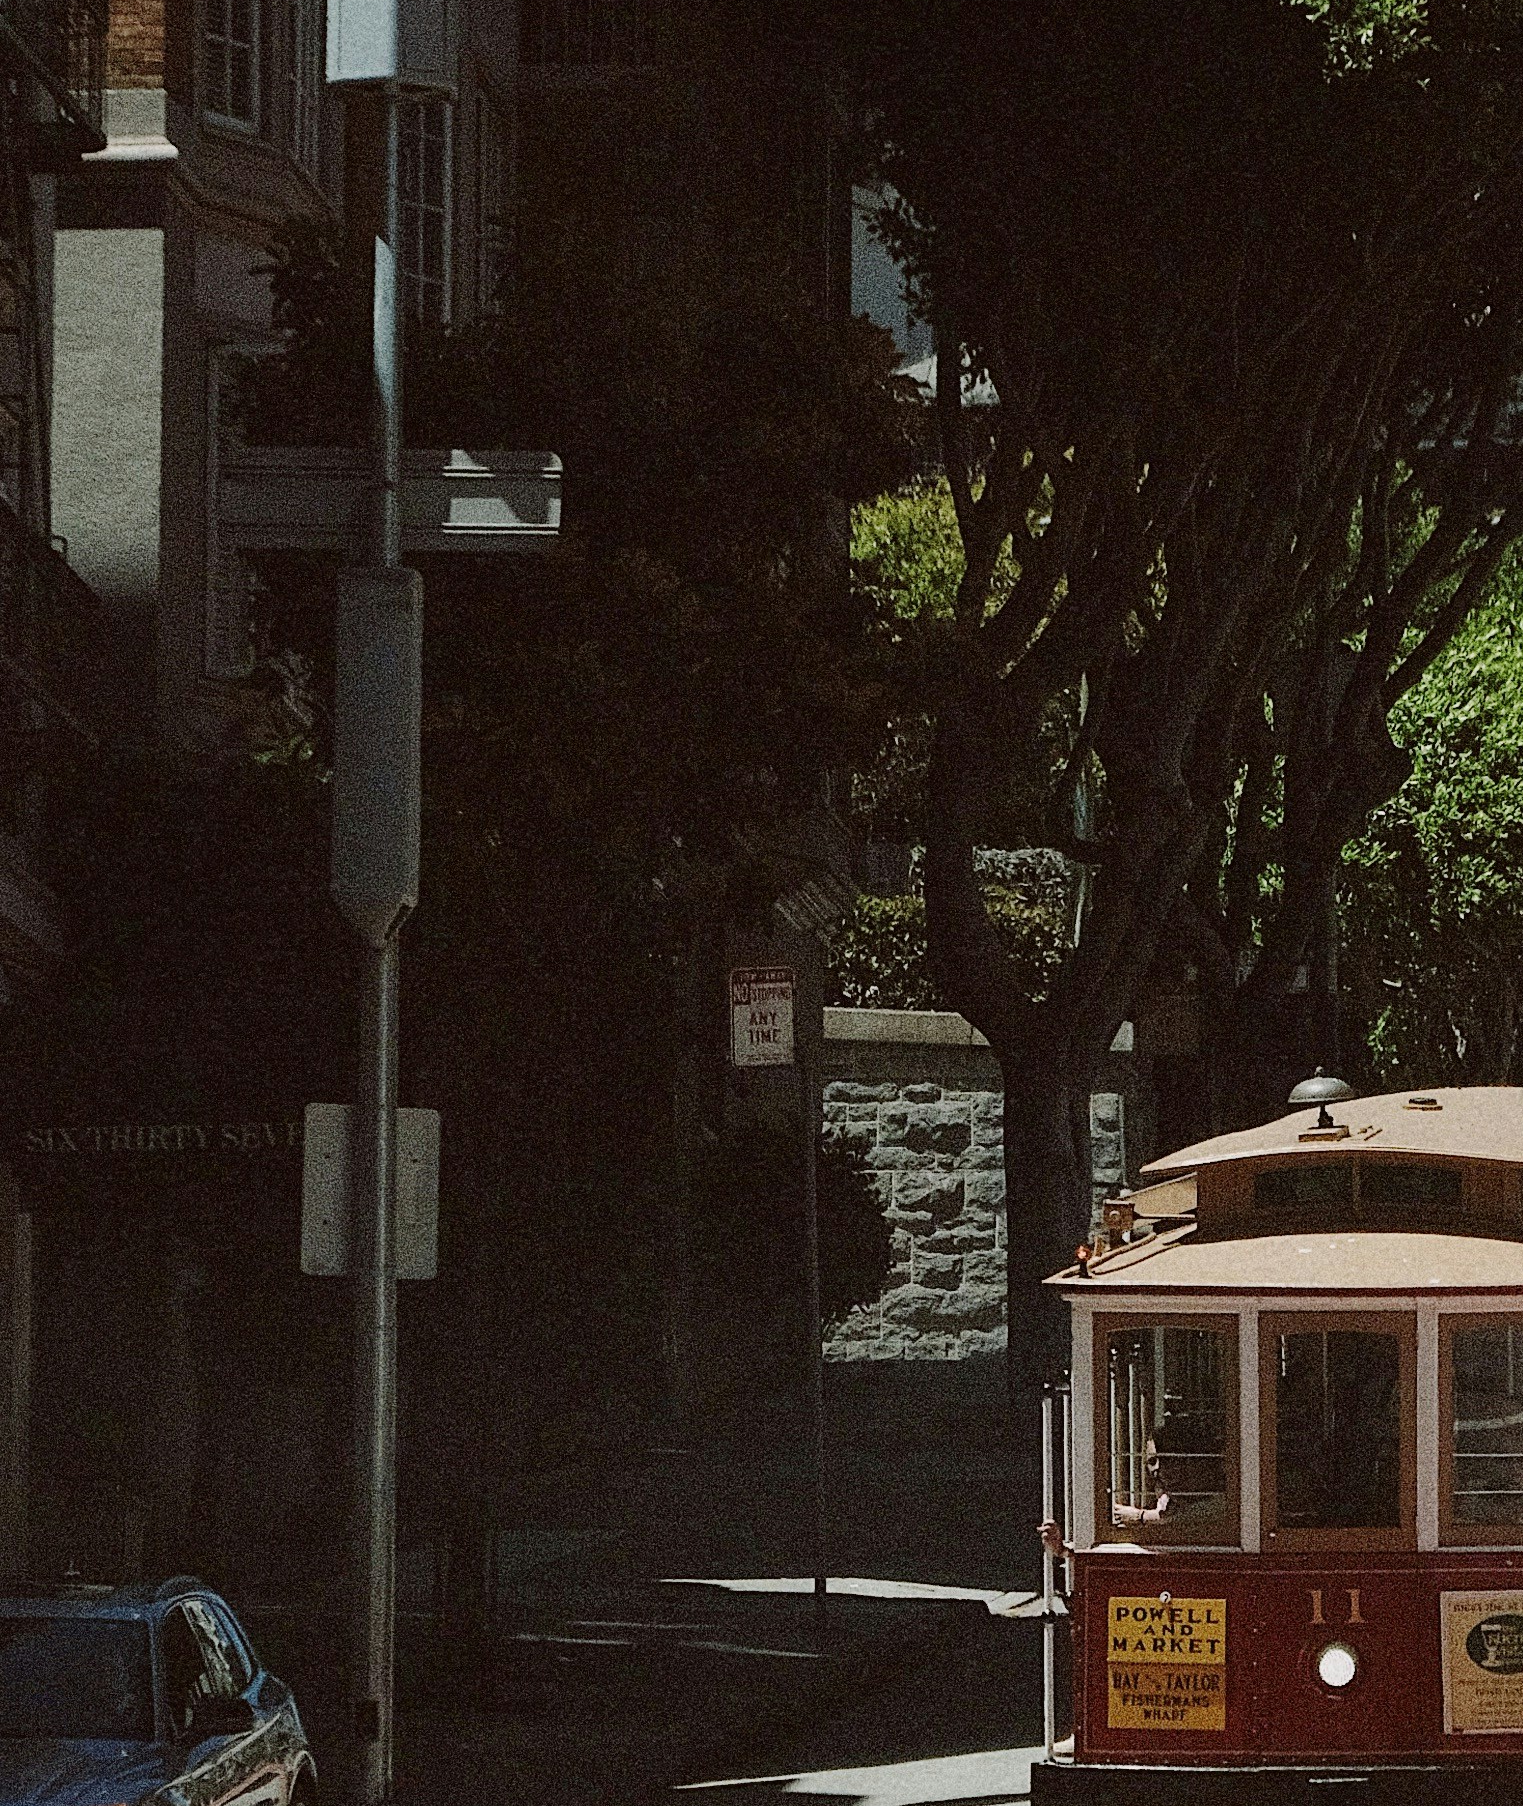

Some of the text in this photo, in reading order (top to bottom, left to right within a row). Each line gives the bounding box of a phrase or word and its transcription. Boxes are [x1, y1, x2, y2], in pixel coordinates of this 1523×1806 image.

[733, 982, 749, 1003] NO
[749, 1012, 777, 1026] ANY
[747, 1029, 781, 1044] TIME
[25, 1126, 80, 1153] SIX
[86, 1123, 214, 1152] THIRTY
[1115, 1606, 1220, 1625] POWELL
[1306, 1589, 1366, 1624] 11
[1143, 1624, 1194, 1636] AND
[1112, 1637, 1221, 1655] MARKET
[1113, 1671, 1140, 1691] BAY
[1166, 1672, 1221, 1692] TAYLOR
[1121, 1694, 1210, 1708] FISHERMANS
[1143, 1709, 1187, 1722] WHARF
